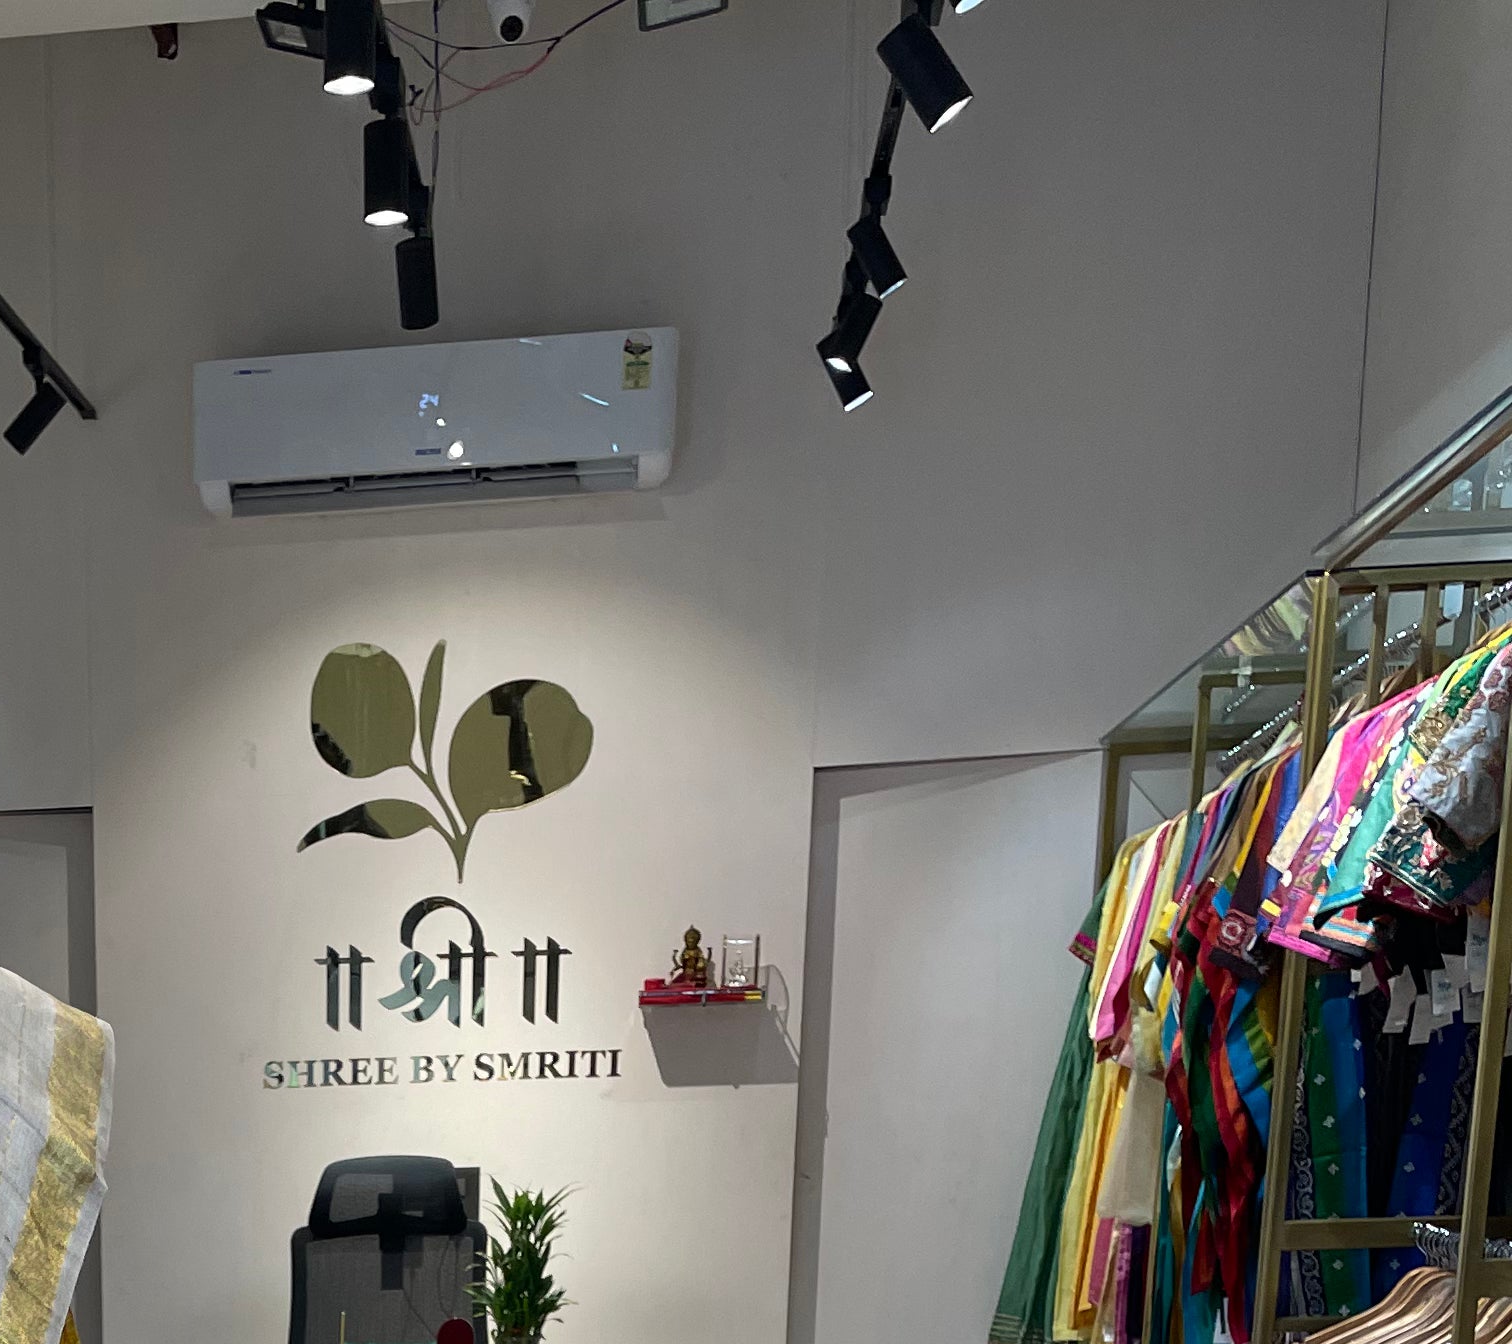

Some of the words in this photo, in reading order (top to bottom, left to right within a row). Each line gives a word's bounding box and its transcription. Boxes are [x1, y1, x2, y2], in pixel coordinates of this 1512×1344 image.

[419, 393, 439, 409] 24
[377, 895, 498, 1028] श्री
[263, 1057, 400, 1089] SHREE
[409, 1054, 465, 1084] BY
[473, 1048, 623, 1081] SMRITI
